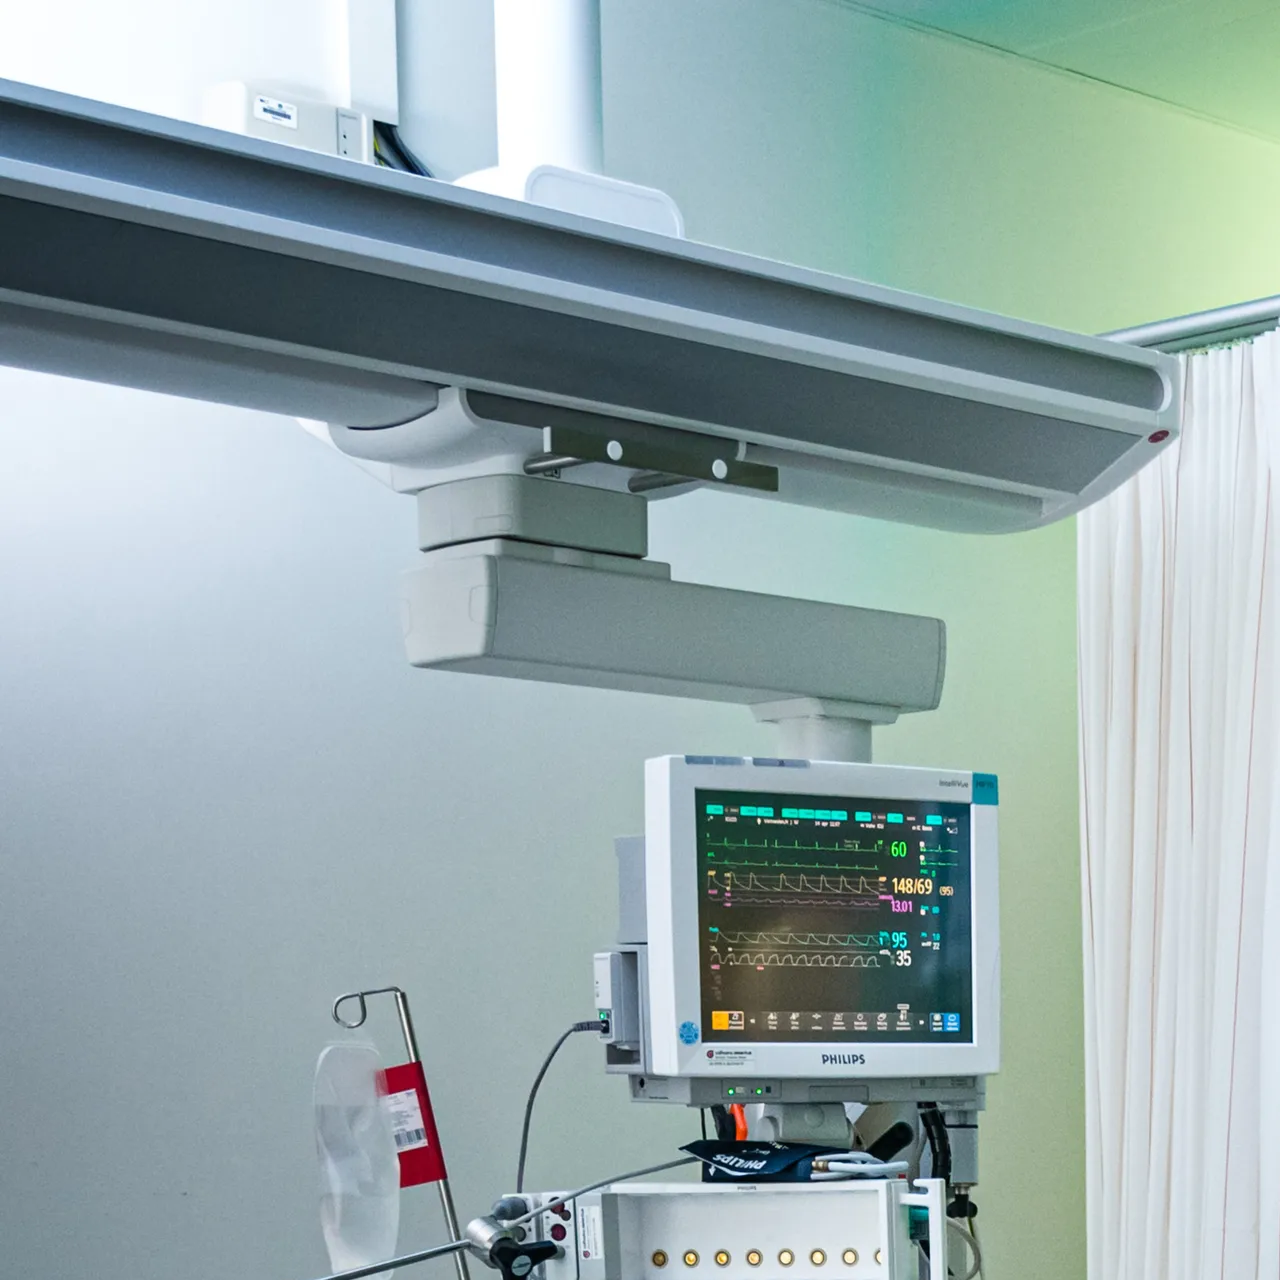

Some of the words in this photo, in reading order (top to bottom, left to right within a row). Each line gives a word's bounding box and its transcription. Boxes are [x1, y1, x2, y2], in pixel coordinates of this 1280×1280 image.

[891, 841, 907, 857] 60
[892, 877, 933, 895] 148/69
[939, 886, 954, 896] (95)
[891, 900, 912, 912] 13.01
[891, 931, 907, 948] 95
[896, 950, 912, 966] 35
[822, 1053, 865, 1065] PHILIPS
[712, 1153, 767, 1170] PHILIPS
